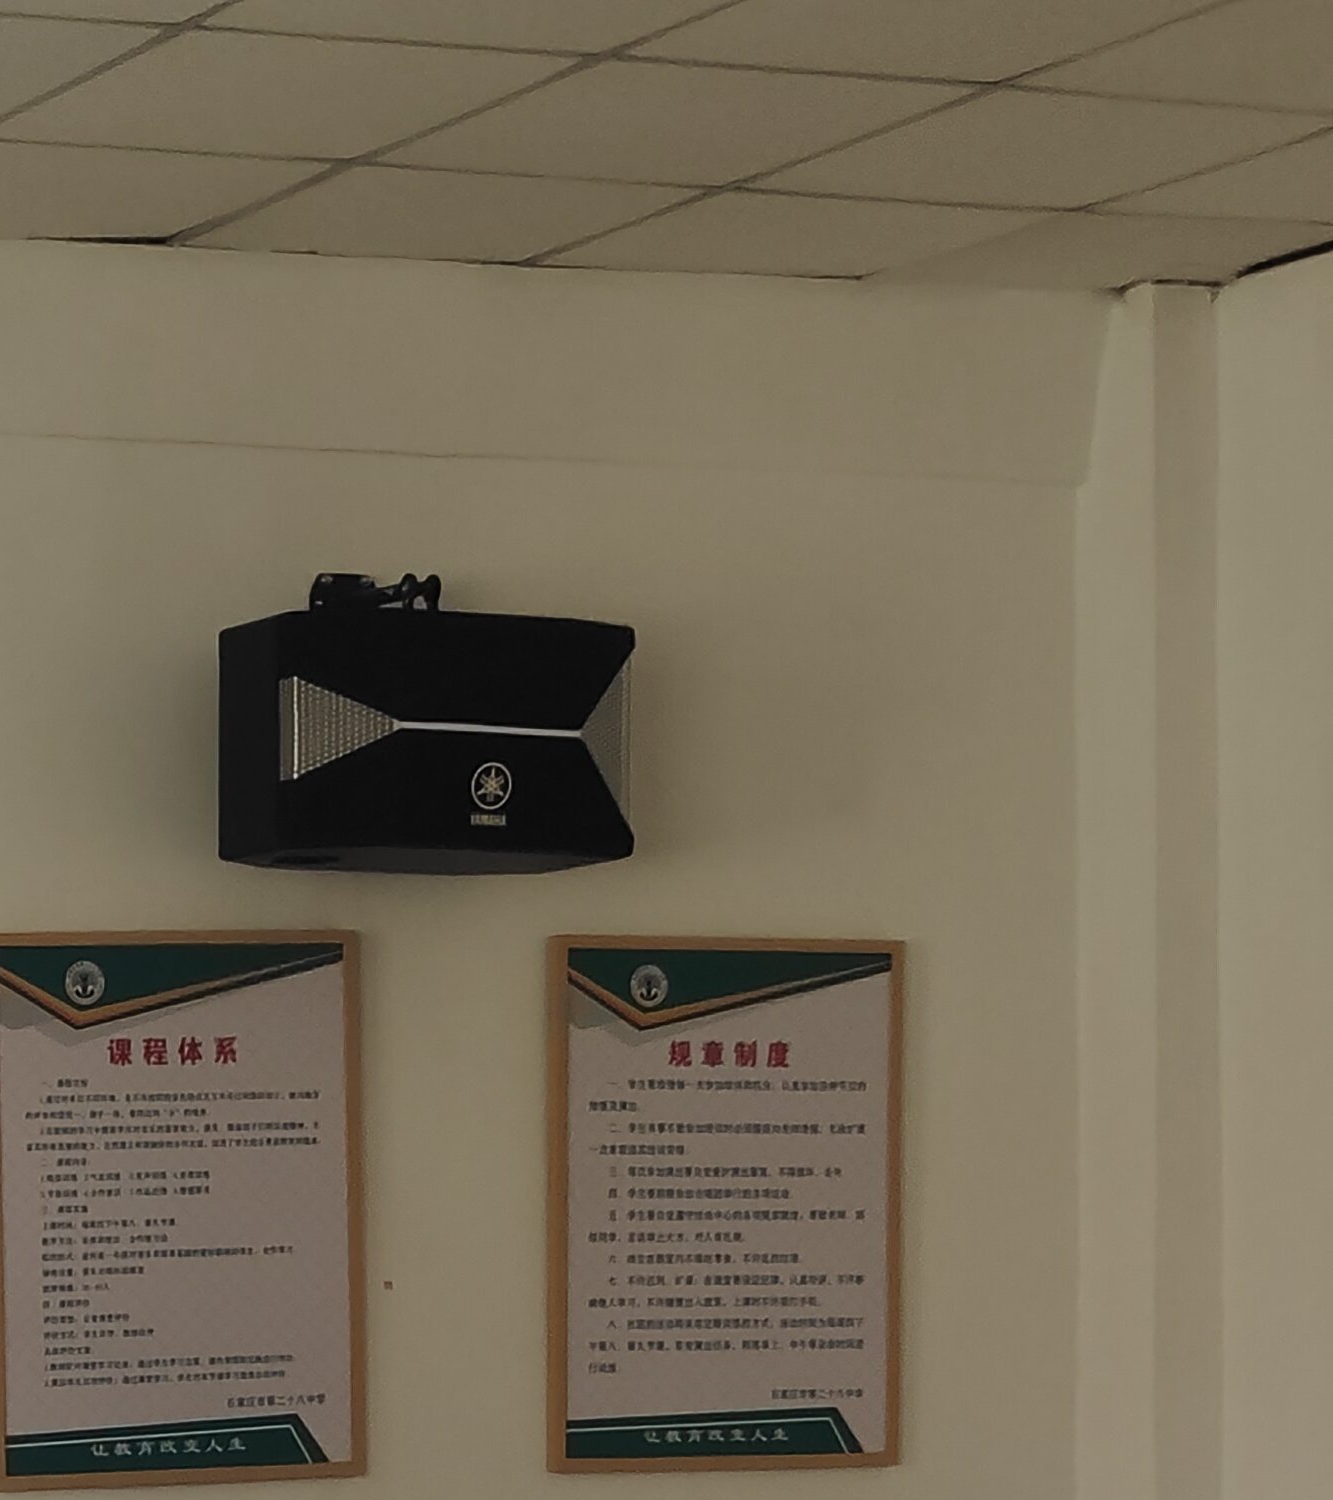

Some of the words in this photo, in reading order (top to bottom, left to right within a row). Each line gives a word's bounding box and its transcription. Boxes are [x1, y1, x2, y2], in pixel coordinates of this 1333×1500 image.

[107, 1036, 238, 1067] 课程体系
[668, 1040, 792, 1068] 规章制度
[90, 1437, 246, 1458] 让教育改变人生
[644, 1428, 789, 1443] 让教育改变人生
